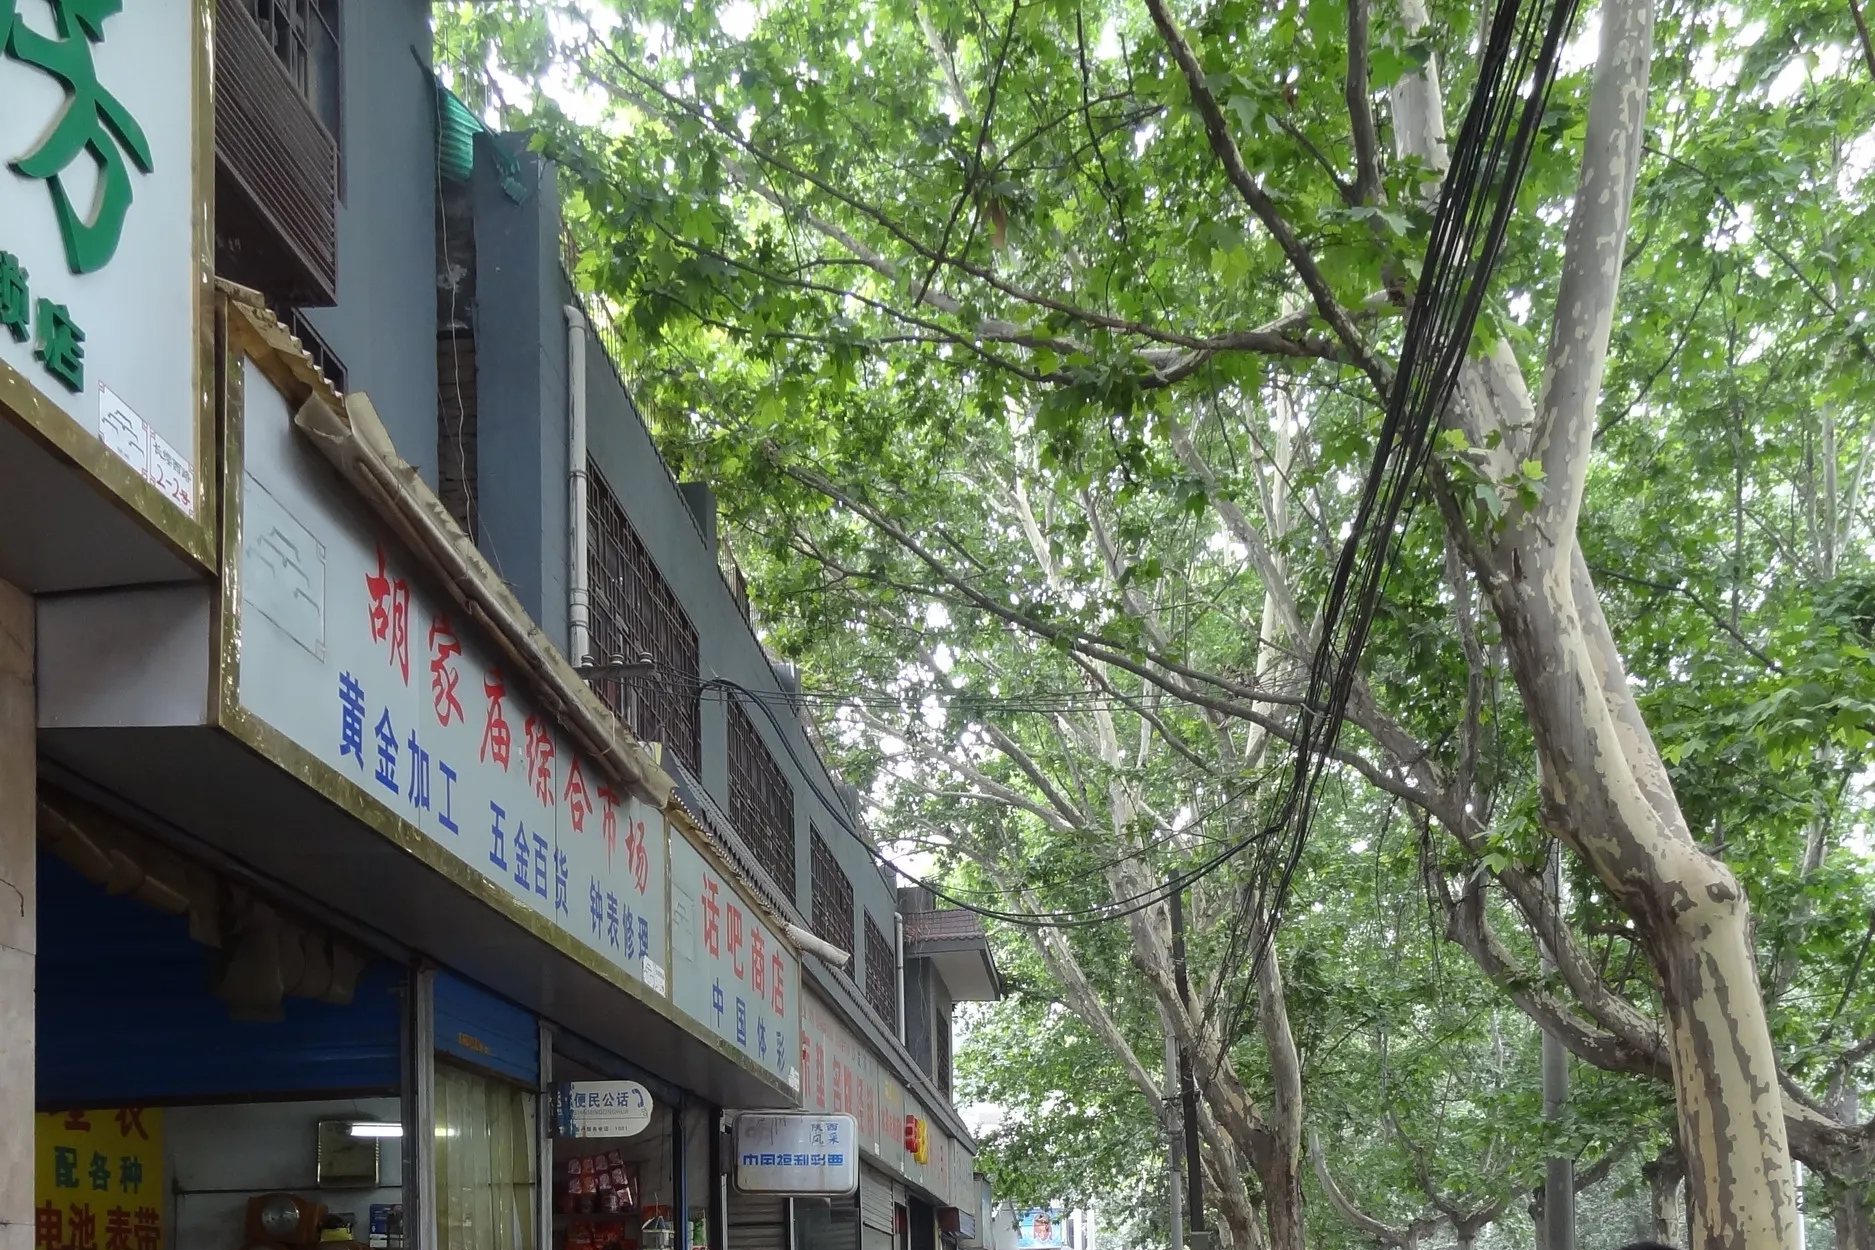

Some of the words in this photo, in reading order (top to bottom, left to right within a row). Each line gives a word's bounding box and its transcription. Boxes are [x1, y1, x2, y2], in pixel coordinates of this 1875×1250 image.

[365, 545, 649, 896] 胡家庙综合市场
[339, 671, 459, 836] 黄金加工
[489, 800, 569, 917] 五金百货
[589, 875, 649, 961] 钟表修理
[701, 872, 785, 1019] 话吧商店
[712, 977, 786, 1072] 中国体彩
[574, 1092, 629, 1108] 便民公话
[811, 1123, 839, 1132] 陕西
[811, 1132, 840, 1145] 风采
[54, 1145, 143, 1194] 配各种
[743, 1153, 843, 1166] 中国福利彩票
